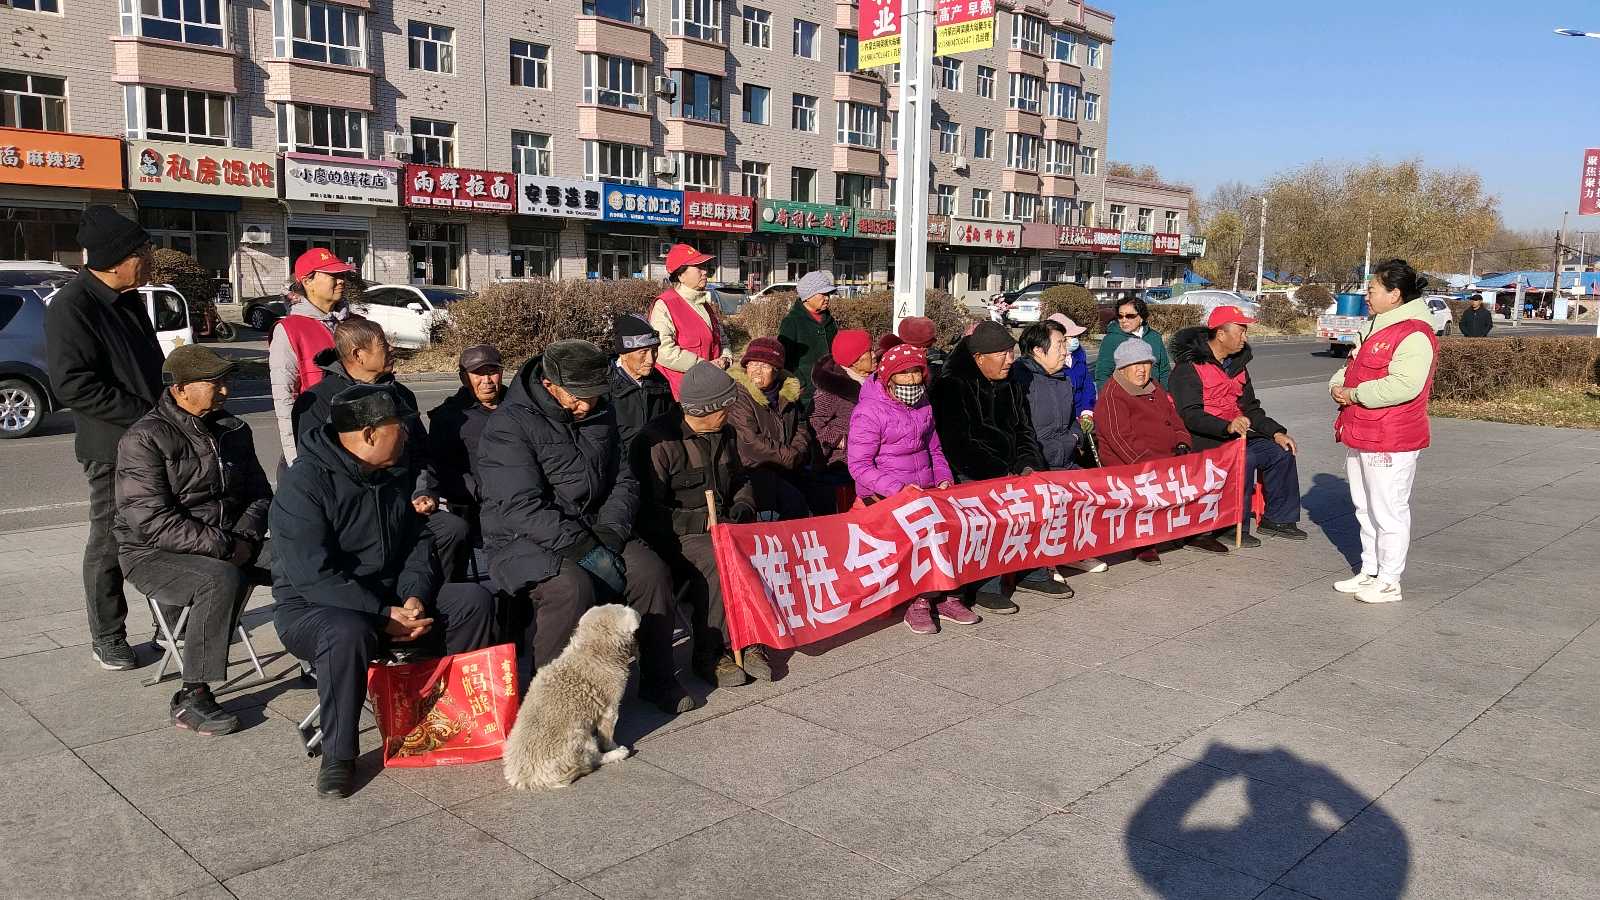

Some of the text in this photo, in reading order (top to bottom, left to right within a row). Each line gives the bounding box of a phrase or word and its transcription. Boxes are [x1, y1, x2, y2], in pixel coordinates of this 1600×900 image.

[872, 0, 897, 36] 业
[939, 0, 992, 22] 高产 早熟
[26, 150, 83, 169] 麻辣烫
[166, 152, 274, 188] 私房馄饨
[299, 167, 384, 187] 小廖的鲜花店
[689, 202, 751, 221] 卓越麻辣烫
[750, 457, 1229, 637] 推进全民阅读建设书香社会
